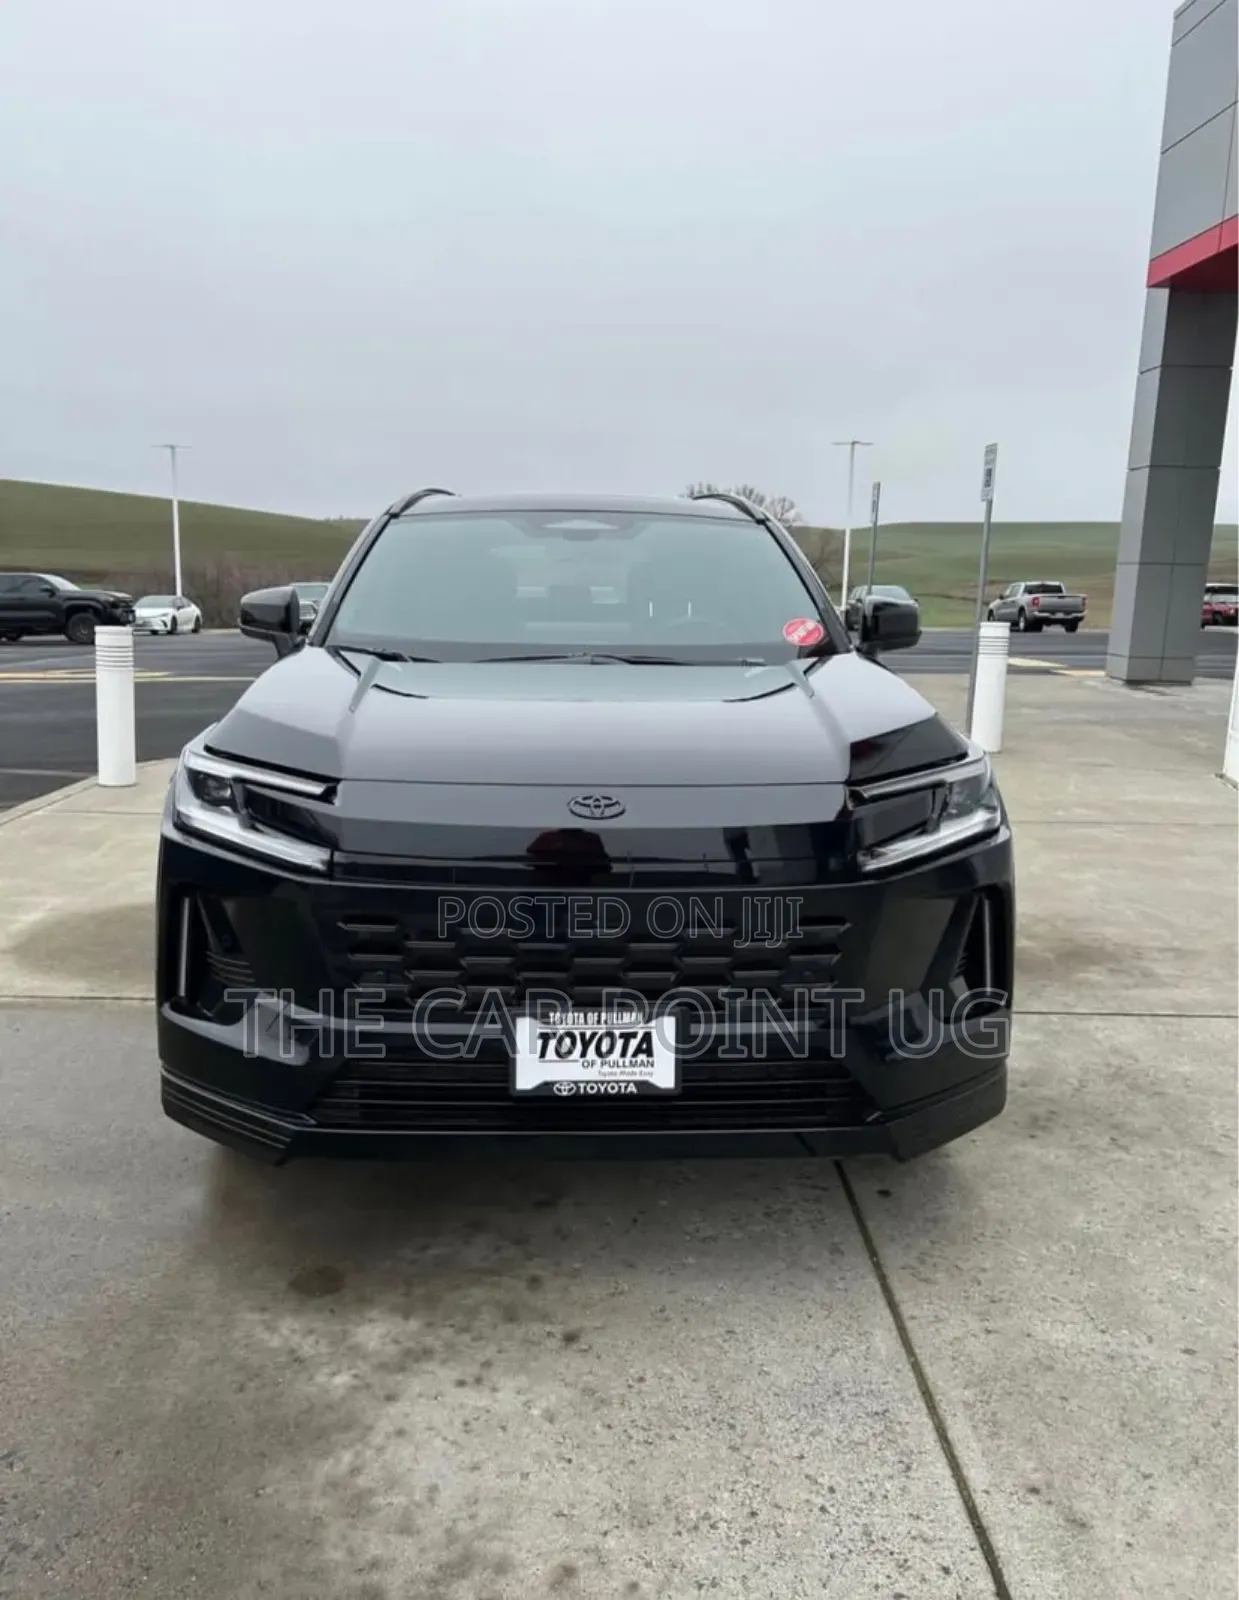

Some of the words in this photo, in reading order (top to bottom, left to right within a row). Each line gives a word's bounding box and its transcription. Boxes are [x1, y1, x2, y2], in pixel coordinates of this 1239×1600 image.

[549, 1012, 584, 1025] TOYOTA
[587, 1012, 599, 1025] OF
[601, 1012, 643, 1025] PULLMAN
[538, 1031, 654, 1059] TOYOTA
[581, 1060, 596, 1069] OF
[600, 1060, 655, 1069] PULLMAN
[577, 1082, 638, 1094] TOYOTA
